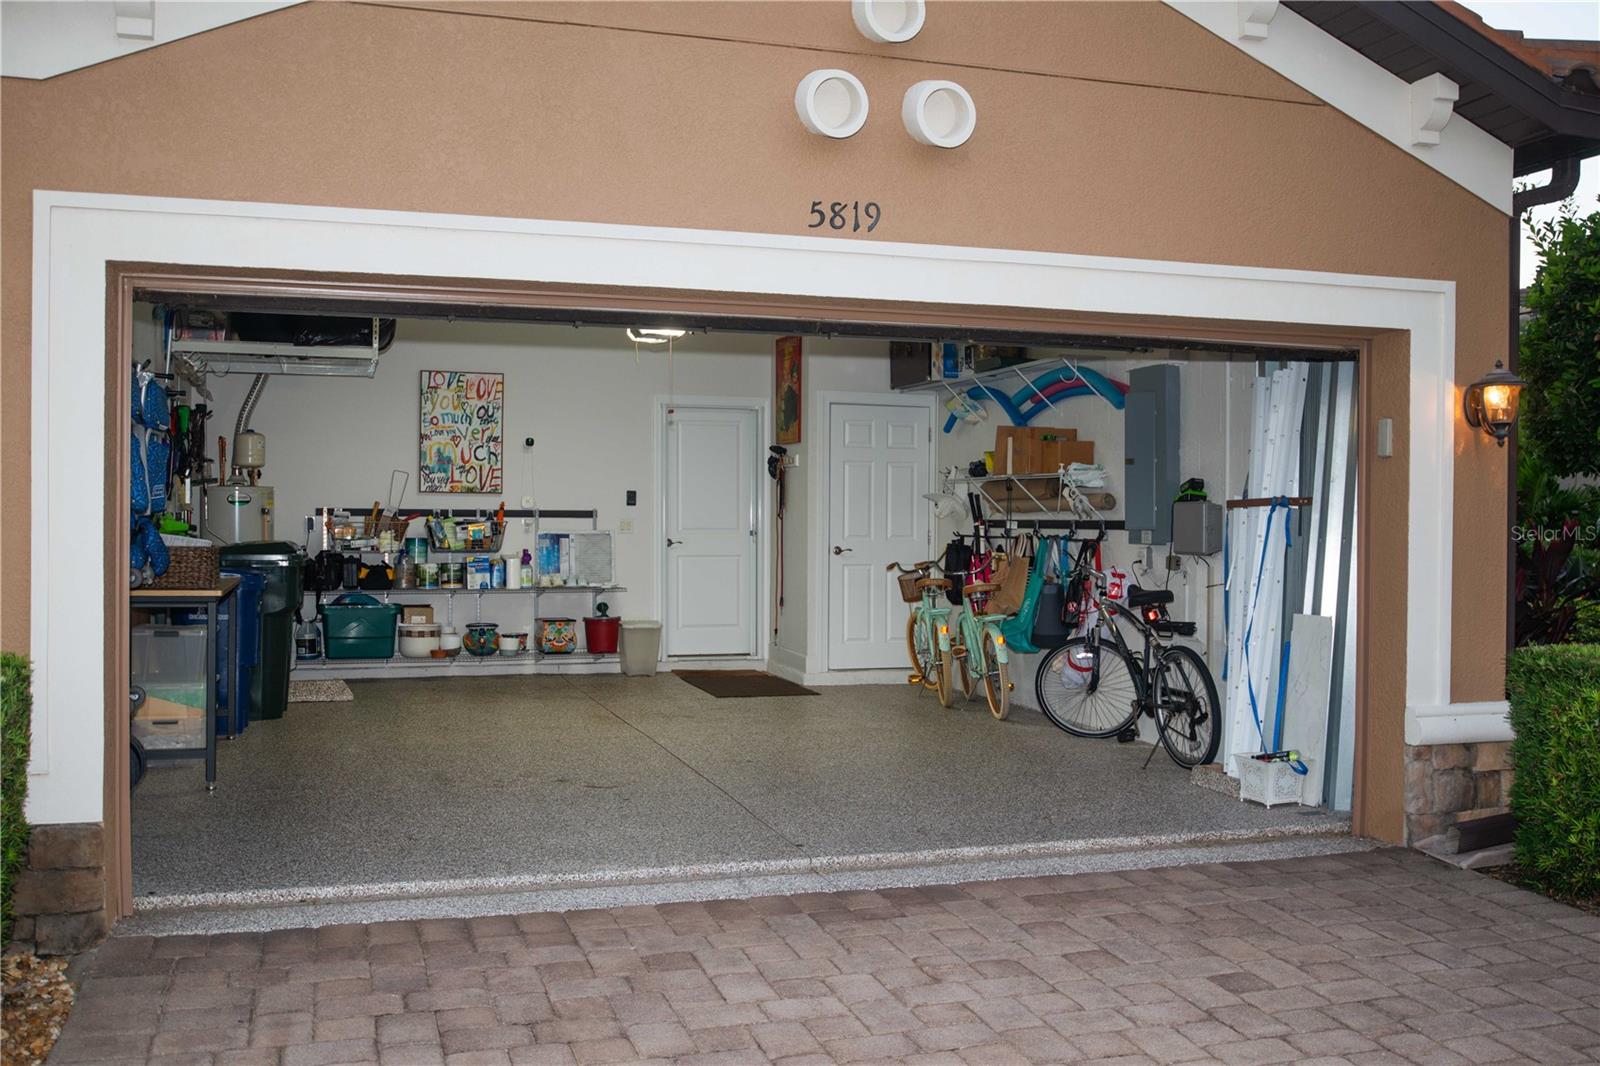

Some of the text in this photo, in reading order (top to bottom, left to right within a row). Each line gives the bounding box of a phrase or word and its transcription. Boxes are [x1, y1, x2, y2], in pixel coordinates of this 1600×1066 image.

[808, 200, 881, 233] 5819
[428, 371, 503, 401] LOVE LOVE
[449, 462, 503, 492] LOVE
